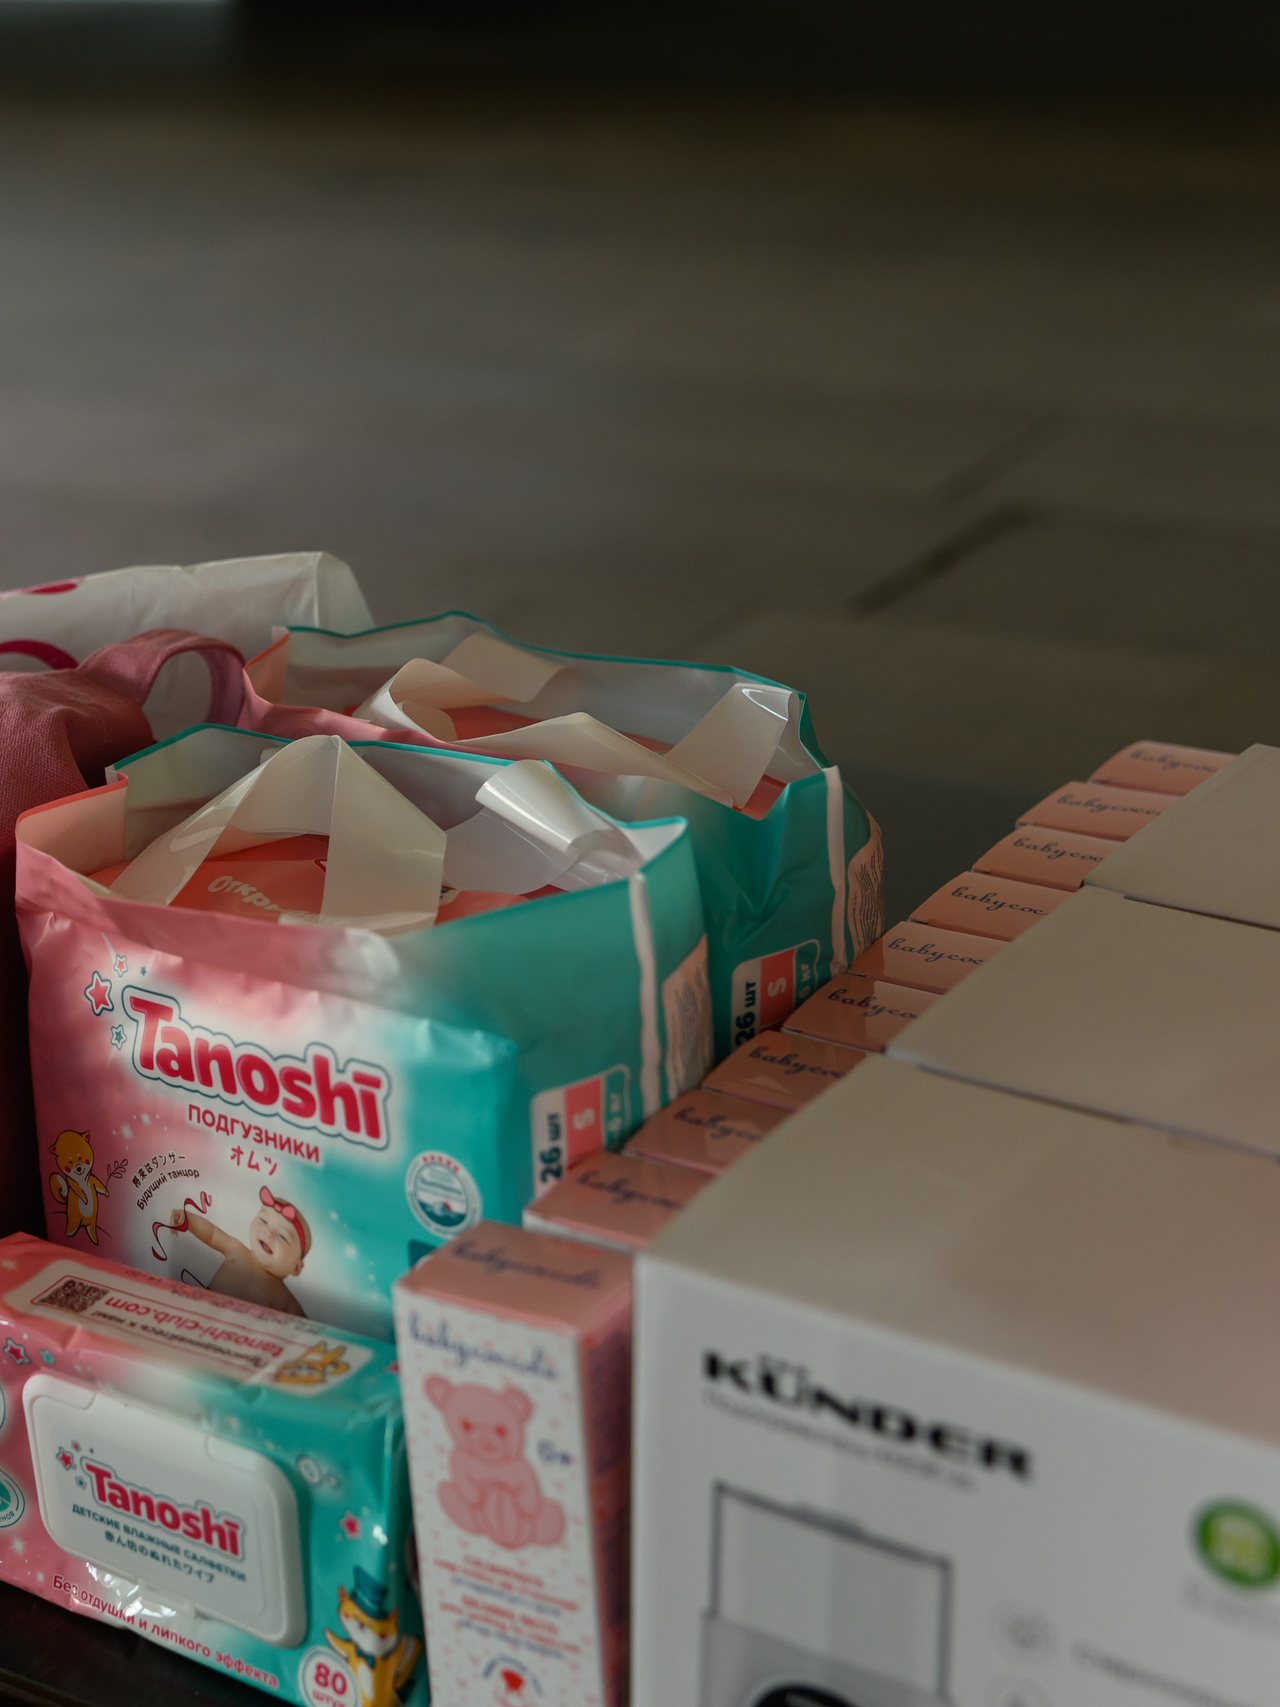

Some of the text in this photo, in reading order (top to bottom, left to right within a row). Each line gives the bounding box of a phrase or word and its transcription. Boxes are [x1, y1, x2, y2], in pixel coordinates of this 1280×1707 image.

[767, 976, 787, 998] S
[187, 1103, 320, 1164] ПОДГУЗНИКИ
[572, 1106, 596, 1132] S
[229, 1144, 278, 1177] オムツ
[539, 1145, 564, 1184] 26
[135, 1167, 201, 1211] Будущий танцор
[104, 1295, 285, 1358] tanoshi-club.com
[72, 1503, 247, 1582] ДЕТСКИЕ ВЛАЖНЫЕ САЛФЕТКИ
[52, 1574, 279, 1689] Без отдушки и липкого эффекта
[313, 1661, 348, 1696] 80
